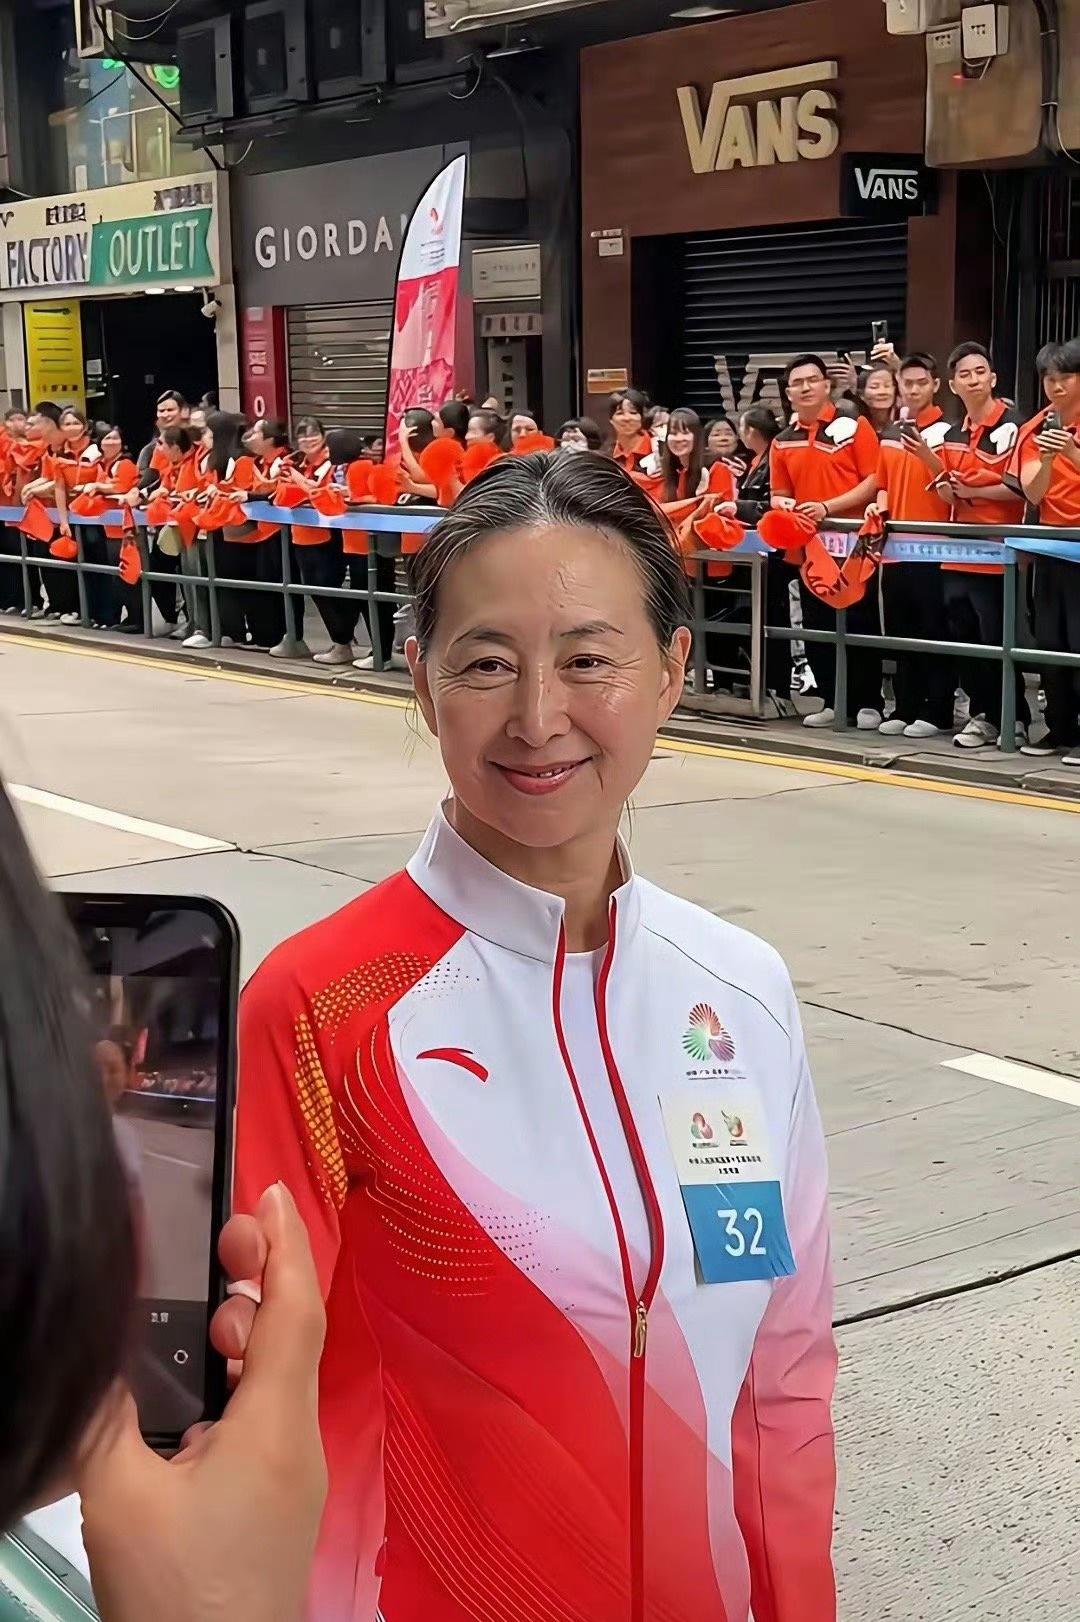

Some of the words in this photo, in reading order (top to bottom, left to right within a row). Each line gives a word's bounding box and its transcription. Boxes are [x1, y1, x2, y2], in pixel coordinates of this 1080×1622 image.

[676, 61, 839, 174] VANS
[854, 167, 919, 200] VANS
[6, 232, 89, 287] FACTORY
[109, 219, 199, 278] OUTLET
[255, 214, 408, 268] GIORDA
[717, 1207, 766, 1257] 32
